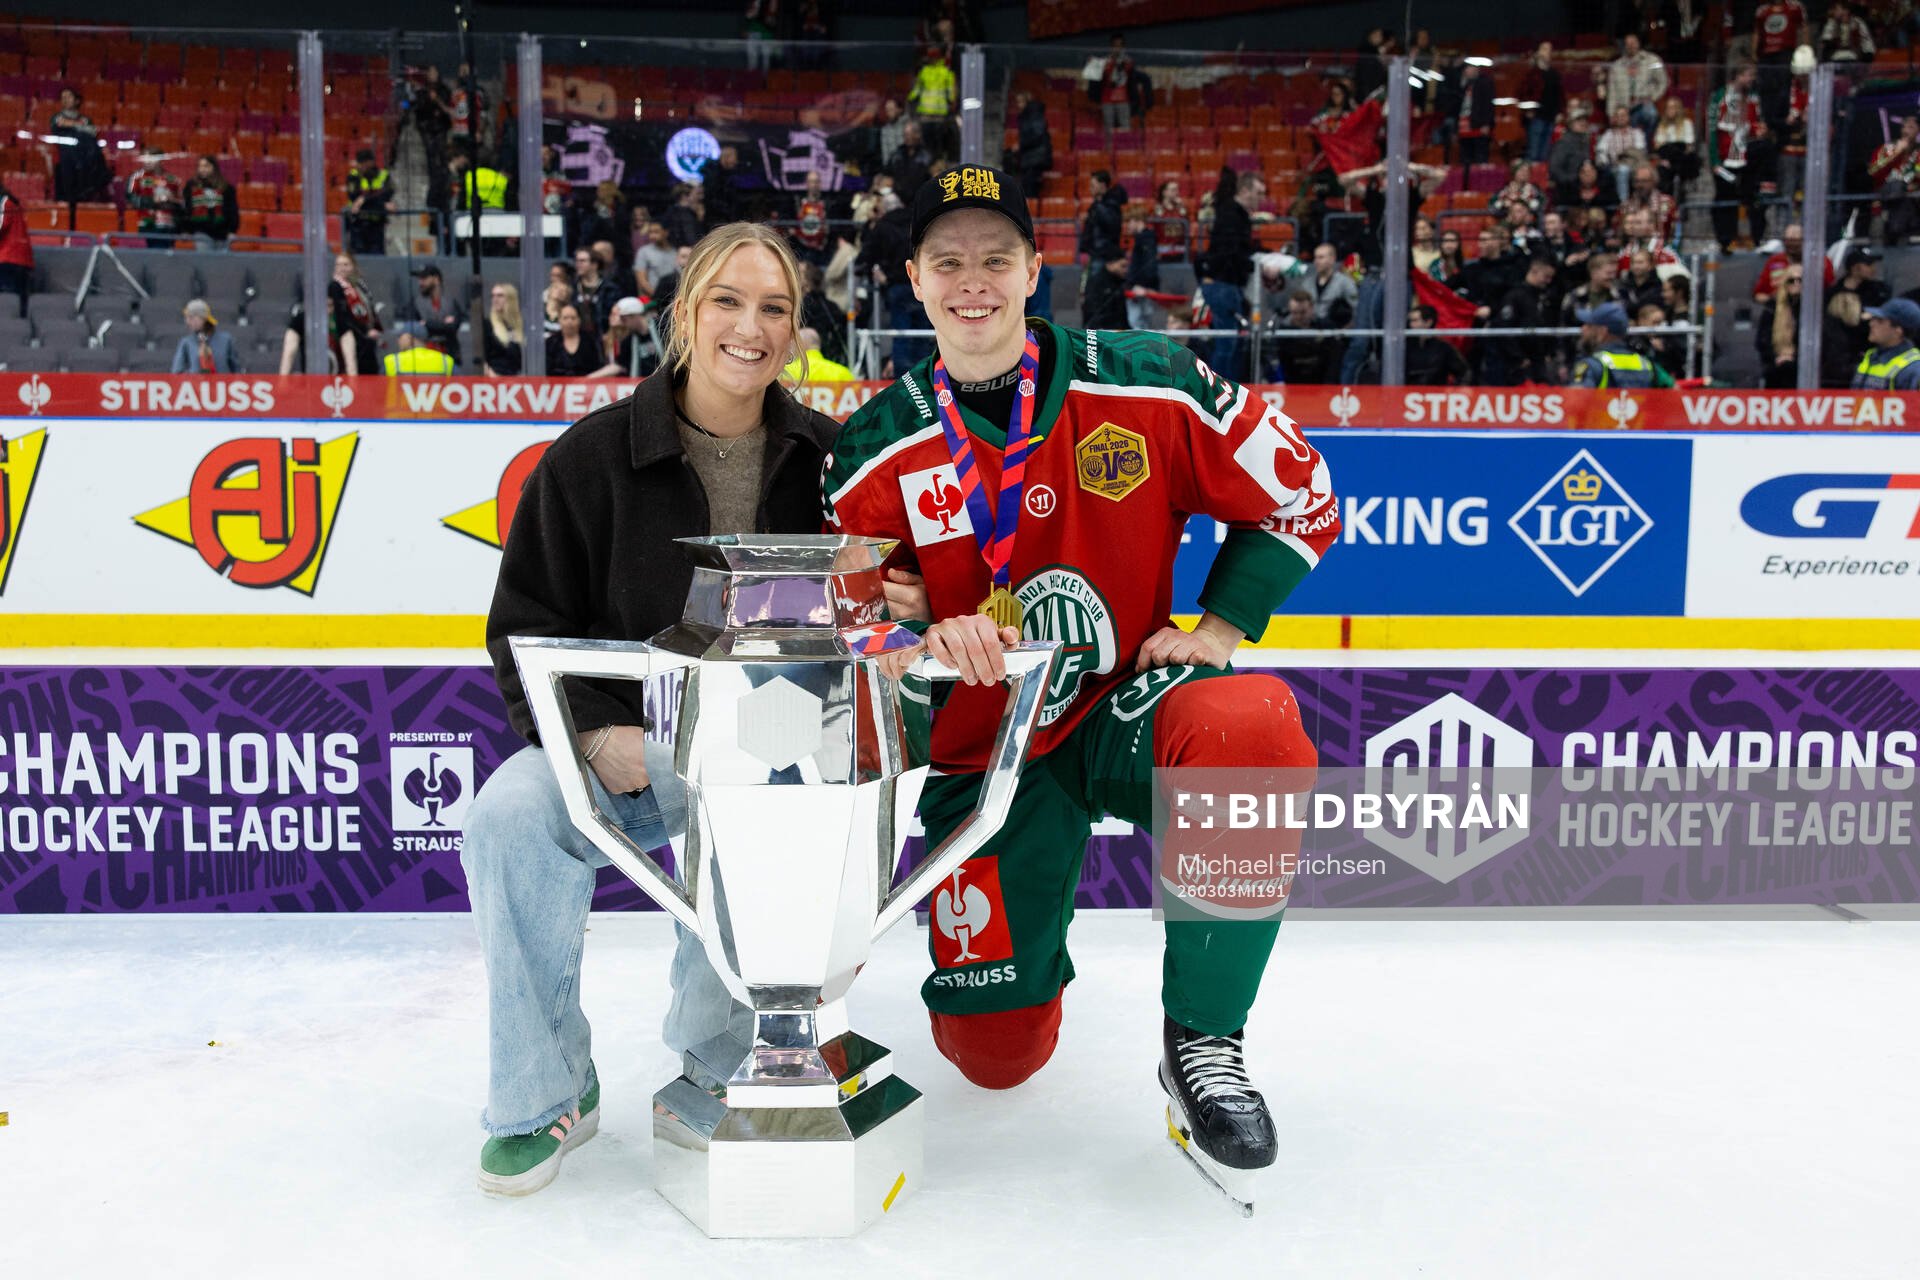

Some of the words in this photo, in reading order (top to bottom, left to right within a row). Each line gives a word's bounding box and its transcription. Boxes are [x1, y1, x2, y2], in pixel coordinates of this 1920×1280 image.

[962, 167, 999, 186] CHL
[963, 185, 1000, 201] 2026
[100, 379, 275, 412] STRAUSS
[1403, 392, 1565, 424] STRAUSS
[1681, 396, 1906, 426] WORKWEAR
[1089, 442, 1109, 453] FINAL
[1109, 439, 1129, 450] 2026
[1535, 504, 1630, 546] LGT
[1761, 555, 1909, 580] Experience
[1083, 590, 1104, 623] CLUB
[389, 732, 456, 742] PRESENTED
[458, 732, 473, 742] BY
[0, 732, 360, 795] HAMPIONS
[1561, 731, 1918, 792] CHAMPIONS
[0, 806, 163, 852] OCKEY
[182, 806, 361, 852] LEAGUE
[1558, 802, 1734, 847] HOCKEY
[1748, 801, 1914, 846] LEAGUE
[392, 836, 464, 852] STRAUS
[933, 964, 1017, 988] STRAUSS
